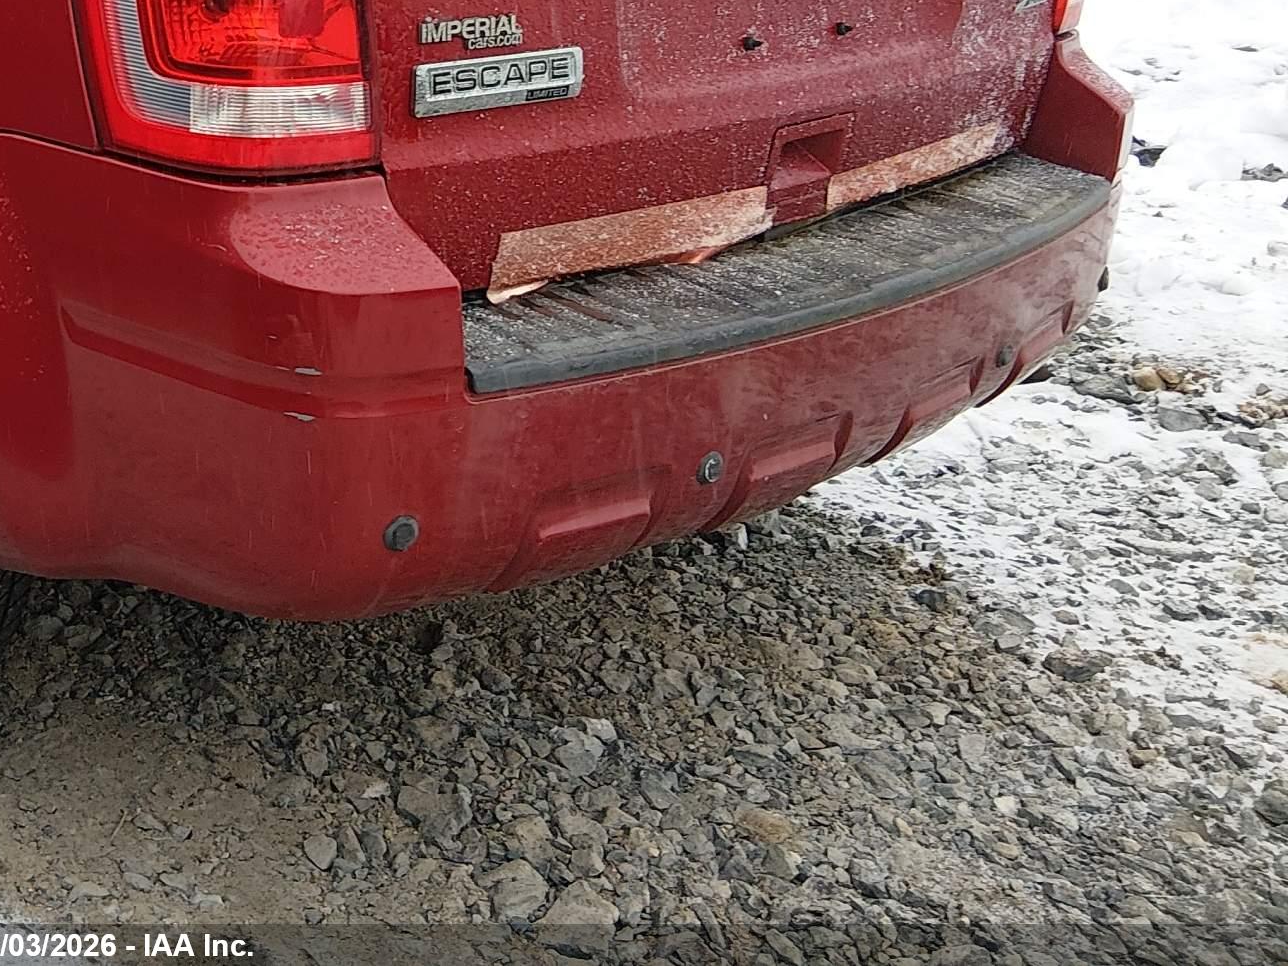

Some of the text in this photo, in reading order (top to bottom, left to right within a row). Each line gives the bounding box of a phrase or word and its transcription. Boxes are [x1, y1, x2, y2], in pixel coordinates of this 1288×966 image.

[420, 14, 524, 44] IMPERIAL
[467, 33, 524, 50] cars.com
[431, 56, 570, 96] ESCAPE
[527, 86, 569, 100] LIMITED
